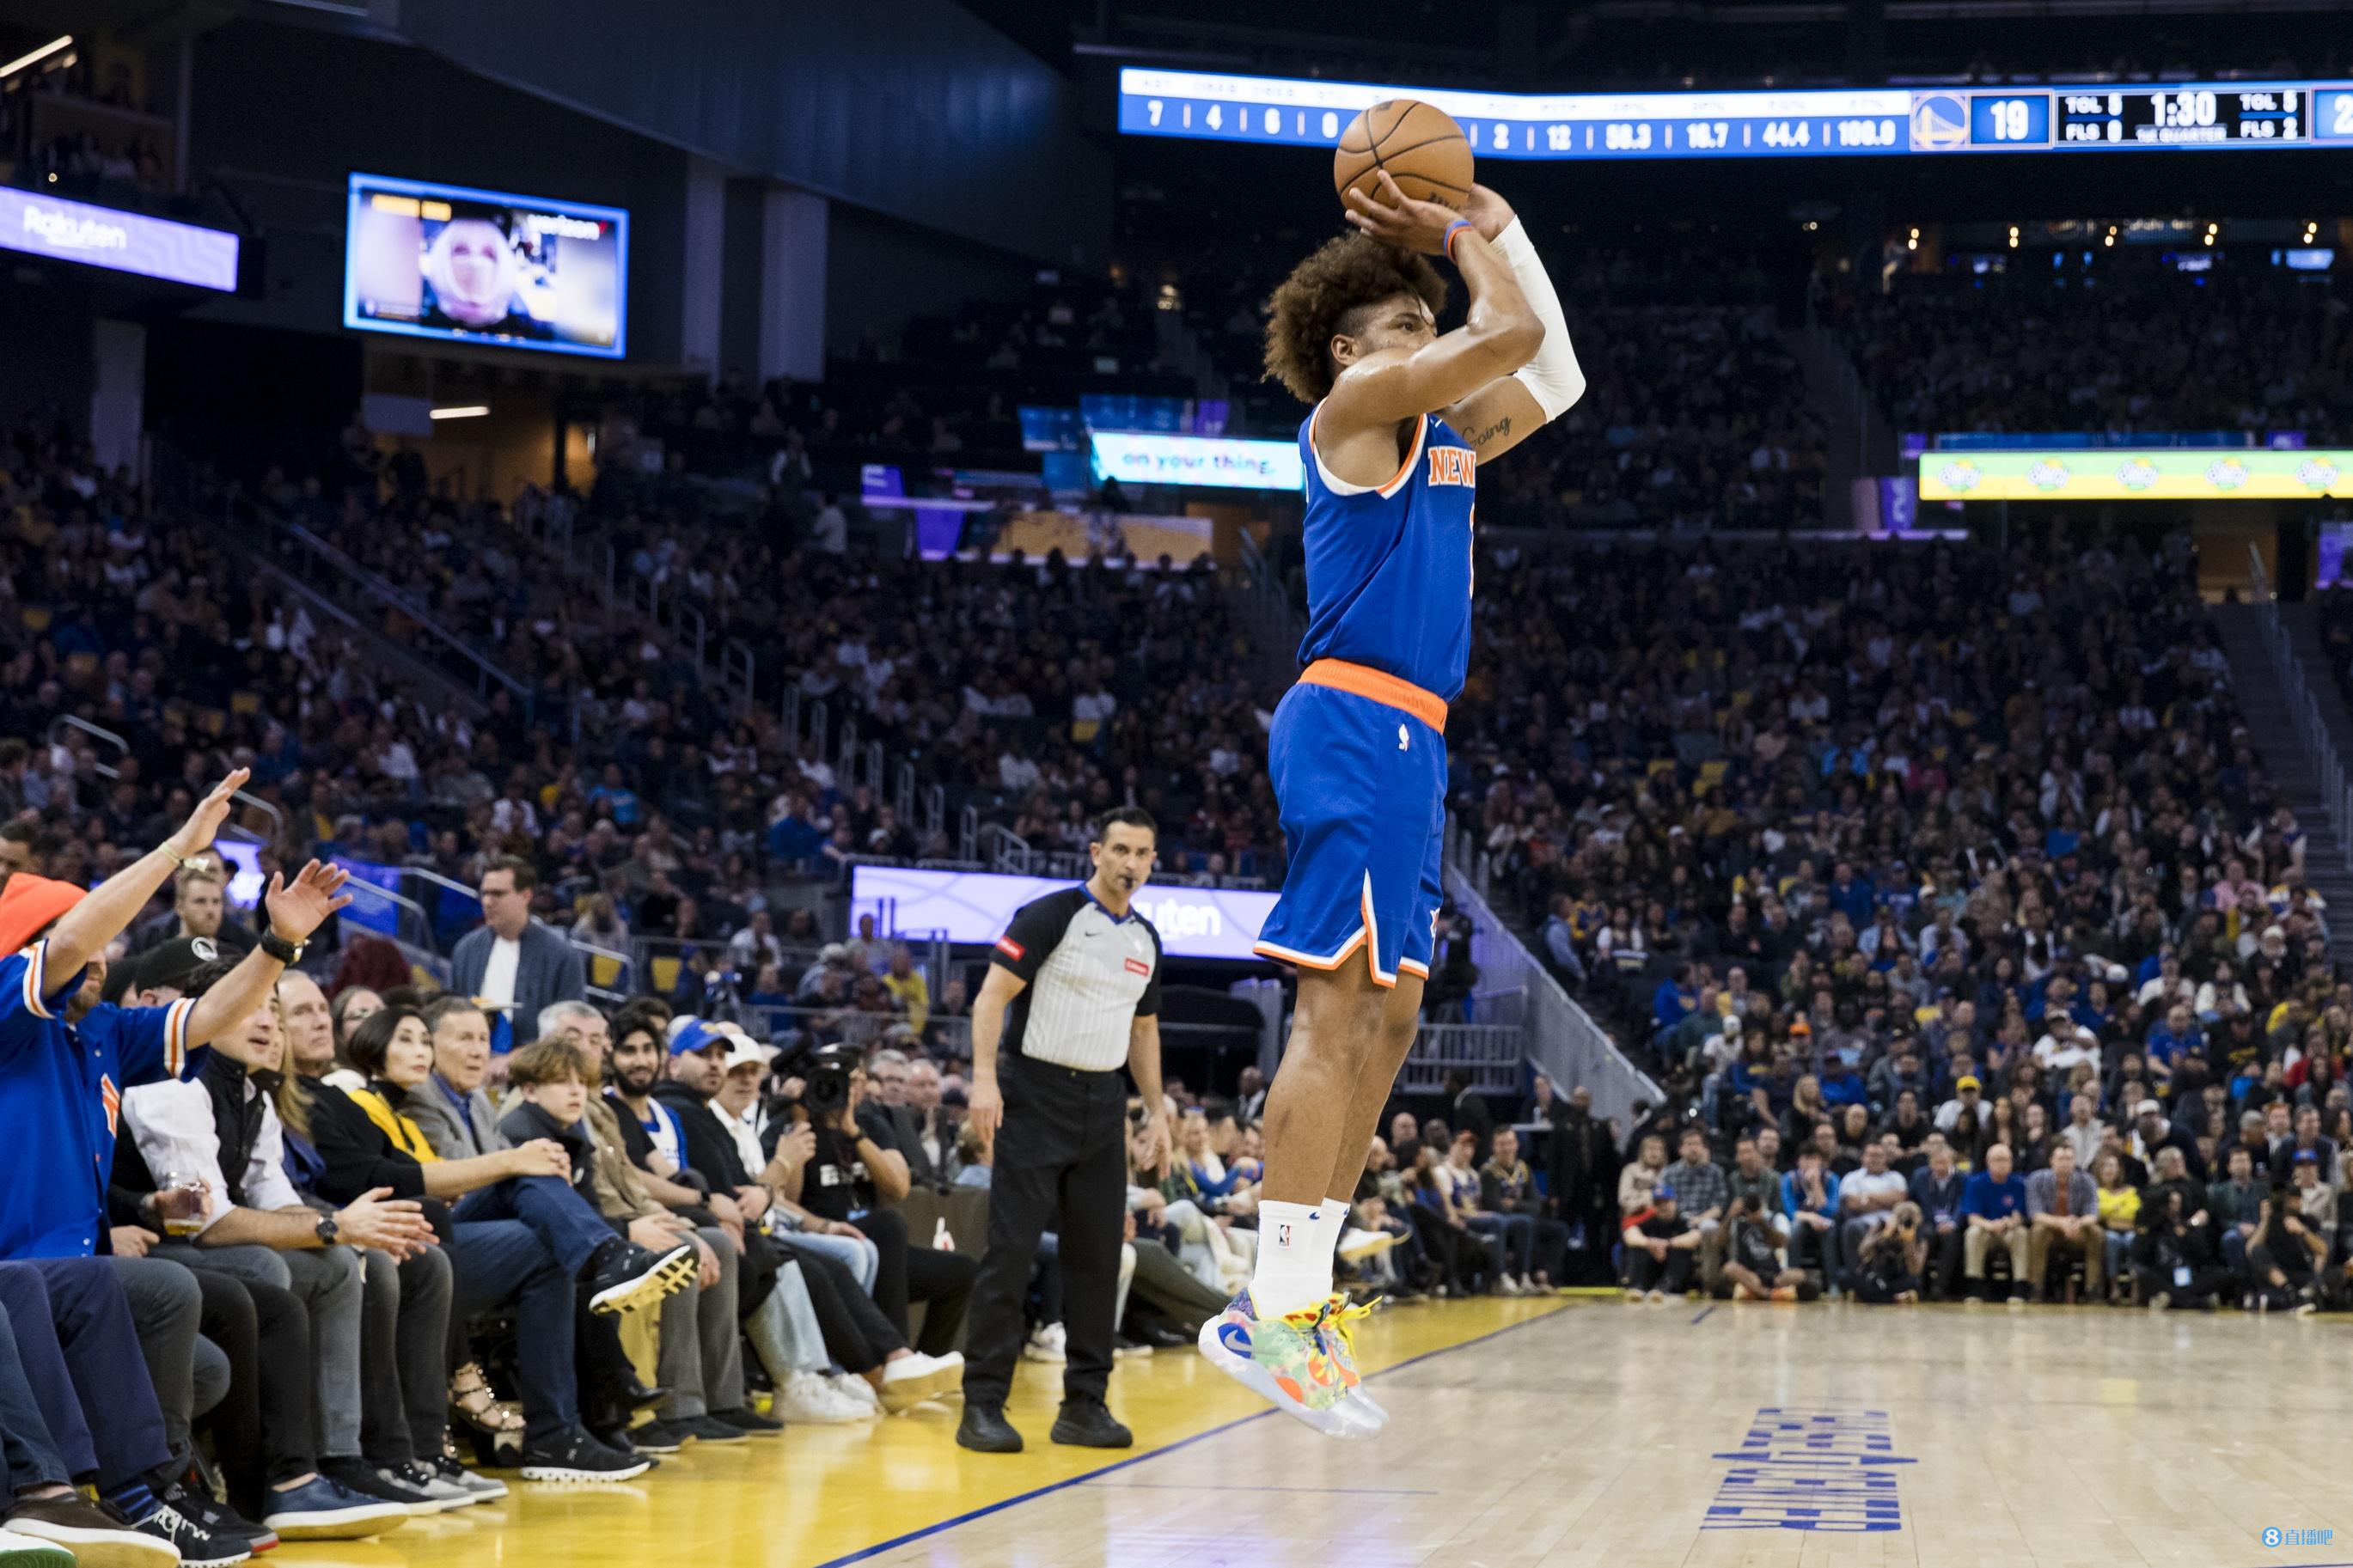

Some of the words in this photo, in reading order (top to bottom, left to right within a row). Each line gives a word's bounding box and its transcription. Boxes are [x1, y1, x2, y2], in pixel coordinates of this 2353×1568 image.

[2065, 96, 2103, 113] TOL
[2150, 90, 2217, 127] 1:30
[2240, 93, 2277, 111] TOL
[1147, 100, 1164, 126] 7
[1206, 104, 1222, 131] 4
[1322, 112, 1339, 138] 0
[1546, 124, 1572, 151] 12
[1762, 121, 1811, 148] 44.4
[1837, 119, 1896, 146] 100.0
[1990, 100, 2029, 141] 19
[2066, 123, 2100, 141] FLS
[2107, 119, 2123, 143] 0
[2240, 120, 2275, 137] FLS
[23, 204, 127, 250] Rakuten
[1462, 416, 1512, 448] Going
[1122, 453, 1150, 468] on
[1156, 454, 1204, 472] your
[1427, 445, 1476, 489] NEW
